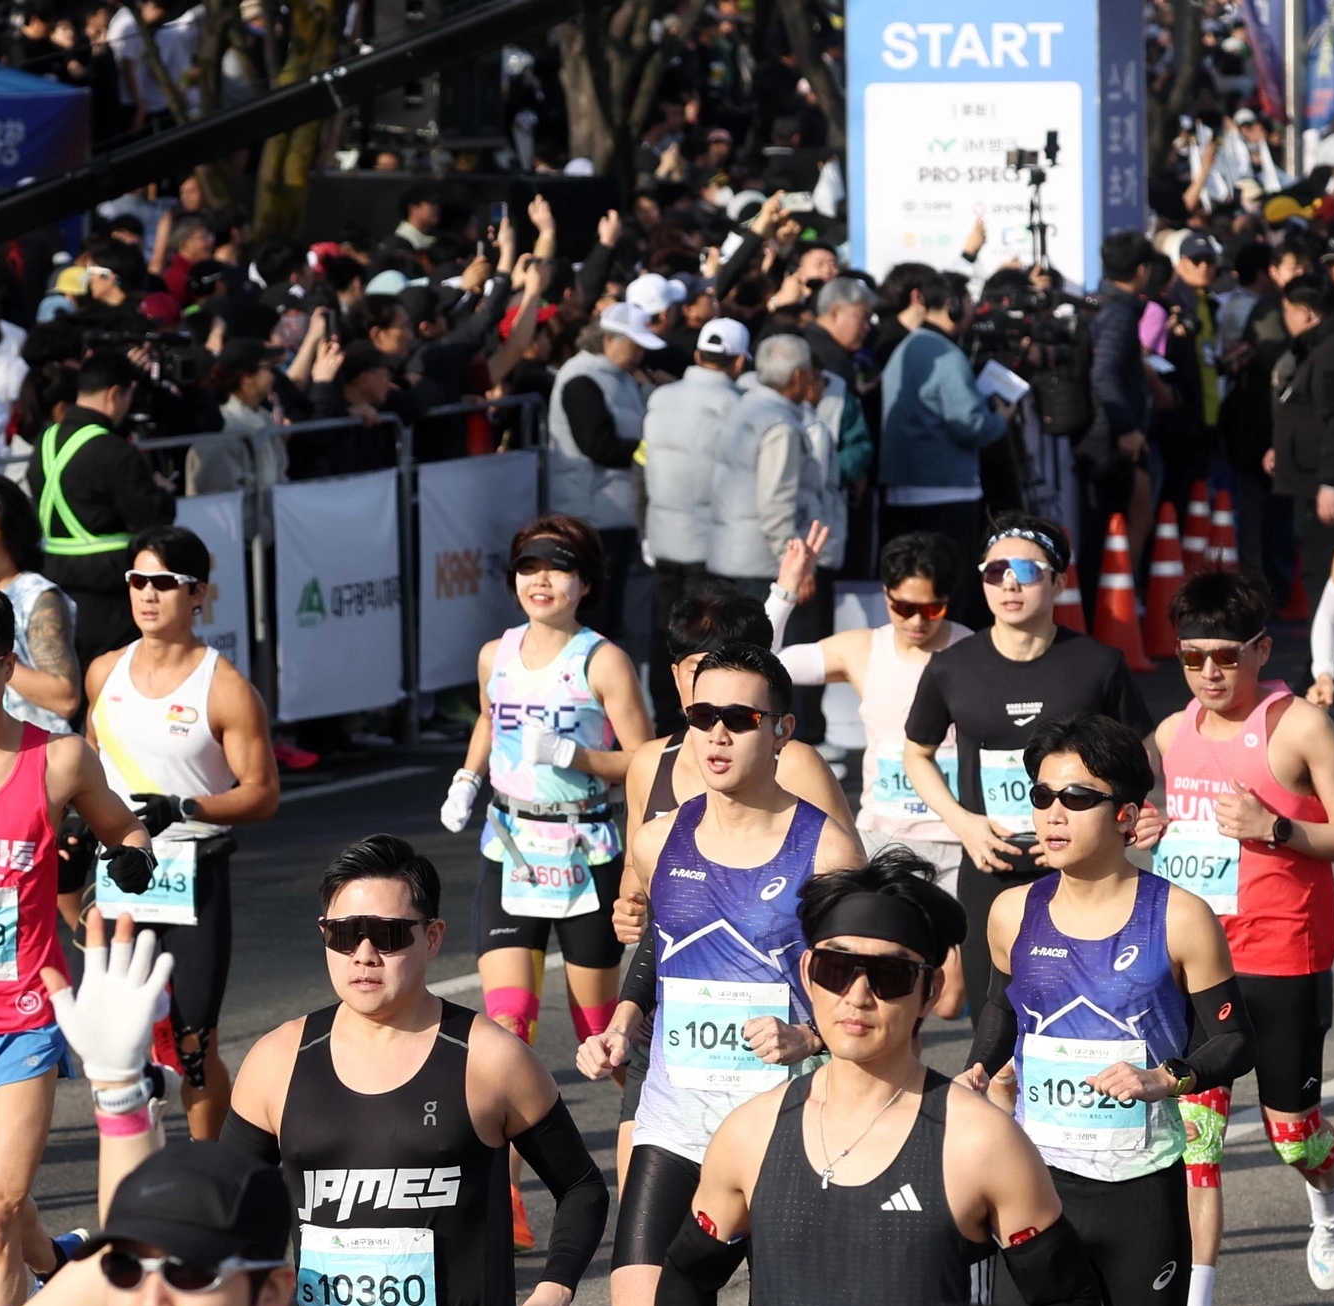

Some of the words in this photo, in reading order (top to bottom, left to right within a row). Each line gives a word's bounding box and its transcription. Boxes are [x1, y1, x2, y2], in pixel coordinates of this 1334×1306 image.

[881, 21, 1065, 71] START
[1173, 776, 1210, 792] DON'T
[1211, 782, 1246, 795] WAL
[669, 867, 707, 881] A-RACER
[1163, 855, 1232, 879] 10057
[1030, 944, 1069, 959] A-RACER
[669, 1030, 680, 1046] S
[1029, 1086, 1039, 1102] S
[297, 1165, 462, 1222] JAMES
[302, 1283, 314, 1302] S
[318, 1274, 426, 1306] 10360
